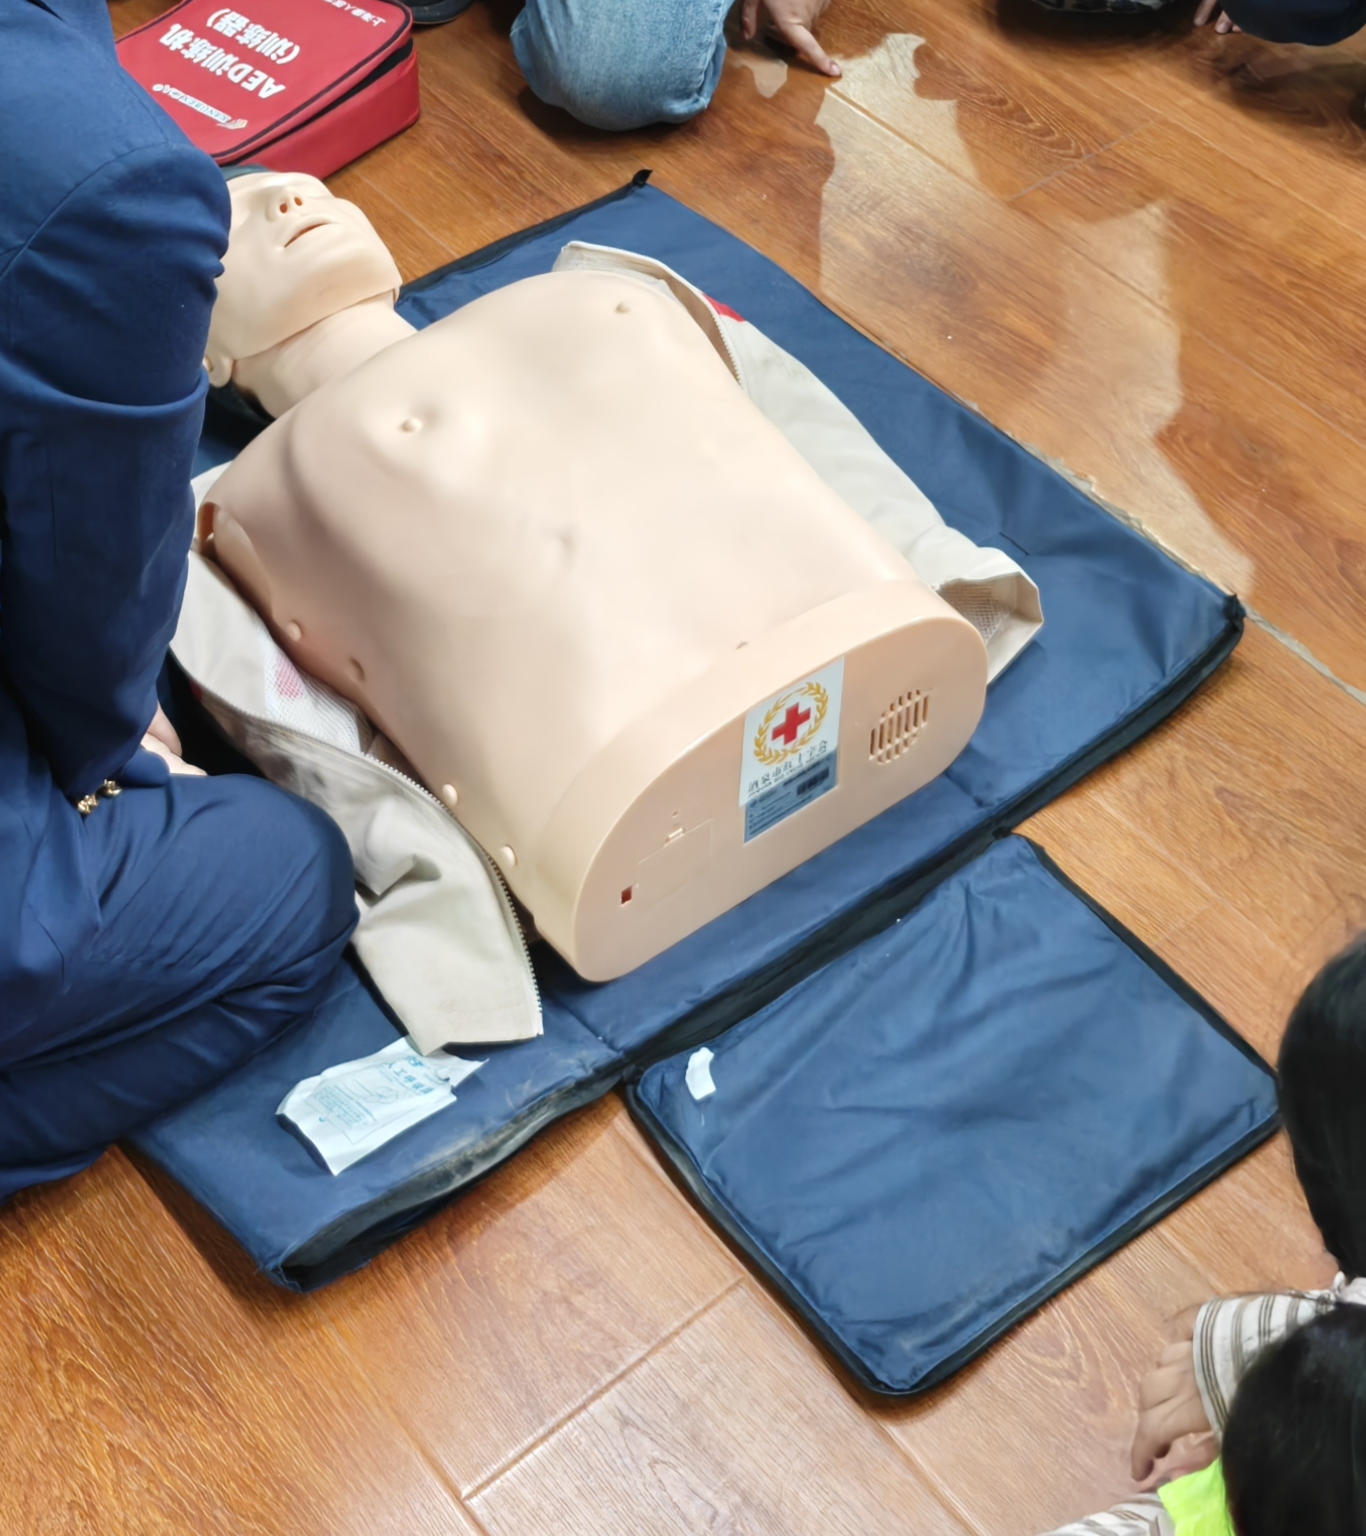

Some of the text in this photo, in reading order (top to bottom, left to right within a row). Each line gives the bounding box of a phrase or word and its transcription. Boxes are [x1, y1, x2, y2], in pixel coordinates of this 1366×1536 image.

[159, 23, 286, 100] AED训练机
[206, 8, 300, 65] (训练器)
